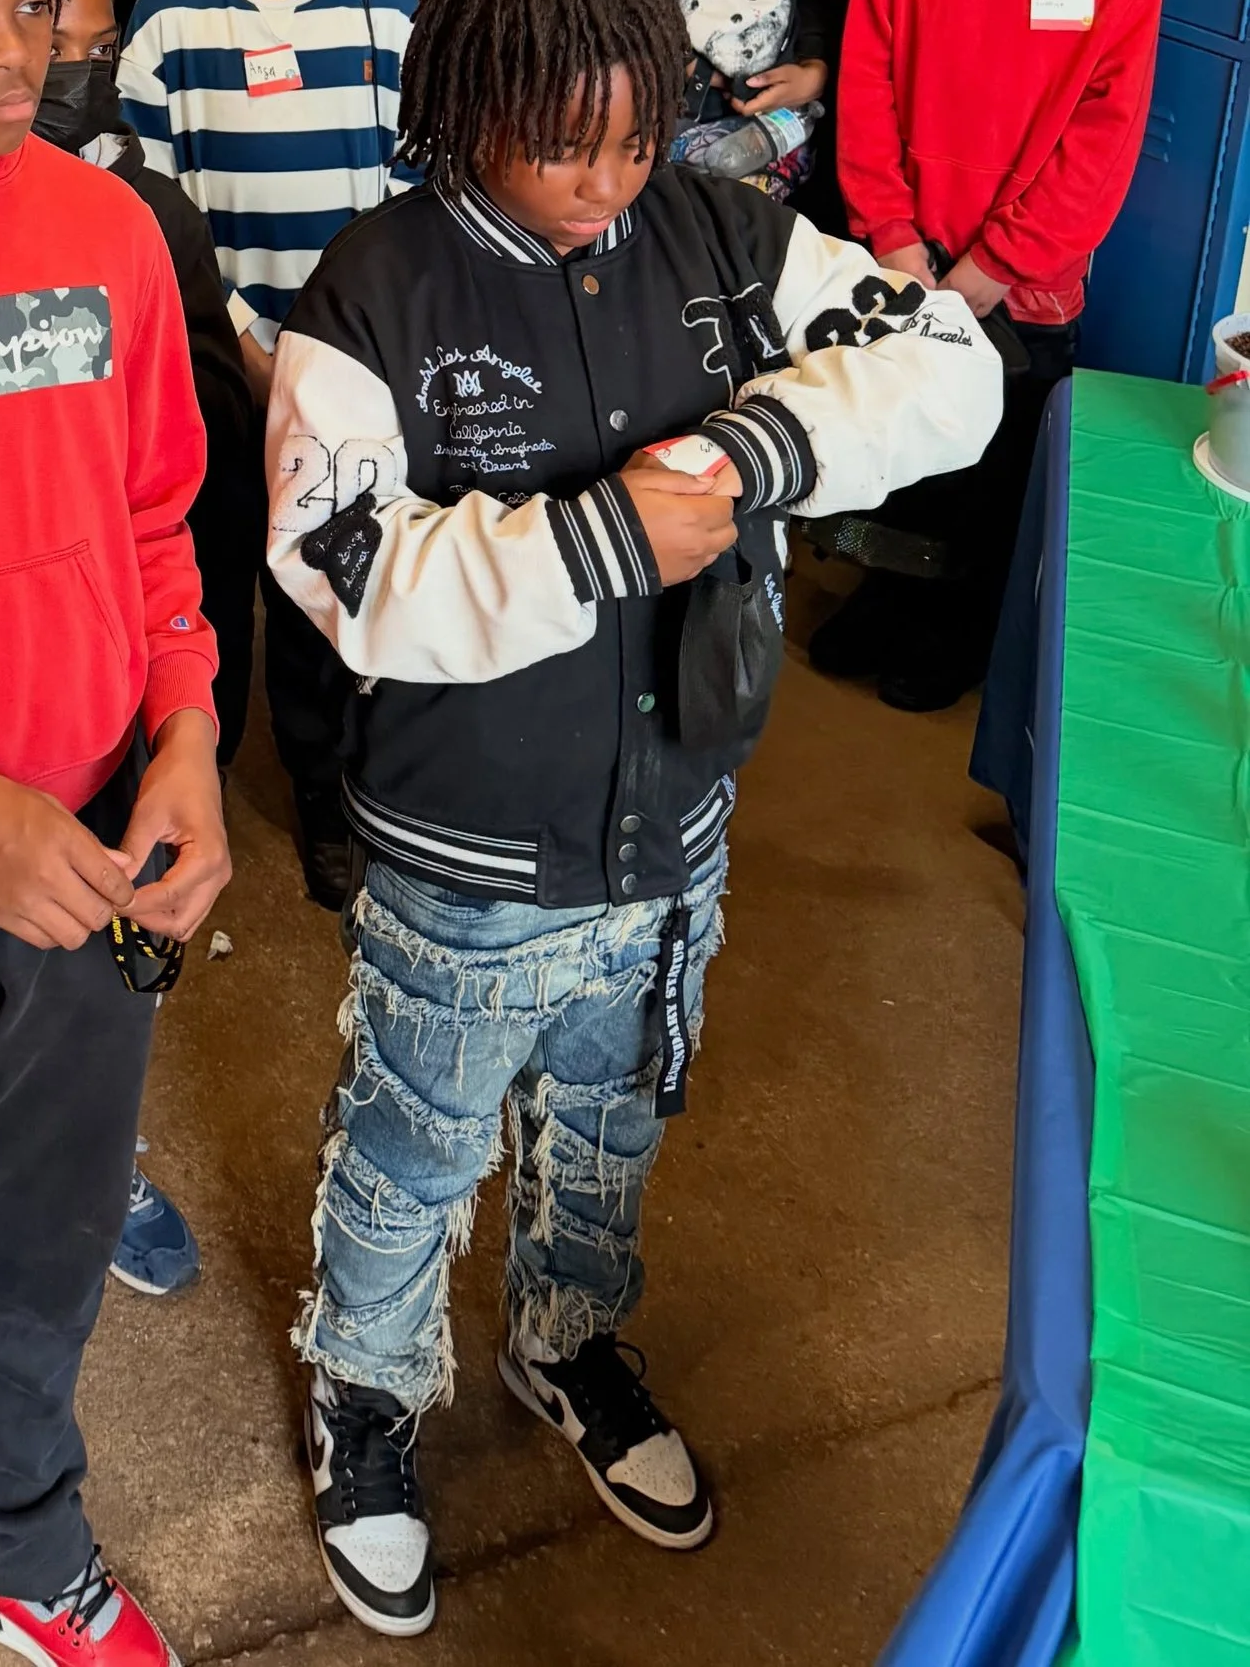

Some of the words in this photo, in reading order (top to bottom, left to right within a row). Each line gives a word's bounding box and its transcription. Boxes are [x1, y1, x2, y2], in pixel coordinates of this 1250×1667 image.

[433, 394, 512, 424] Engineered
[450, 421, 526, 445] California
[664, 938, 685, 1000] STATUS
